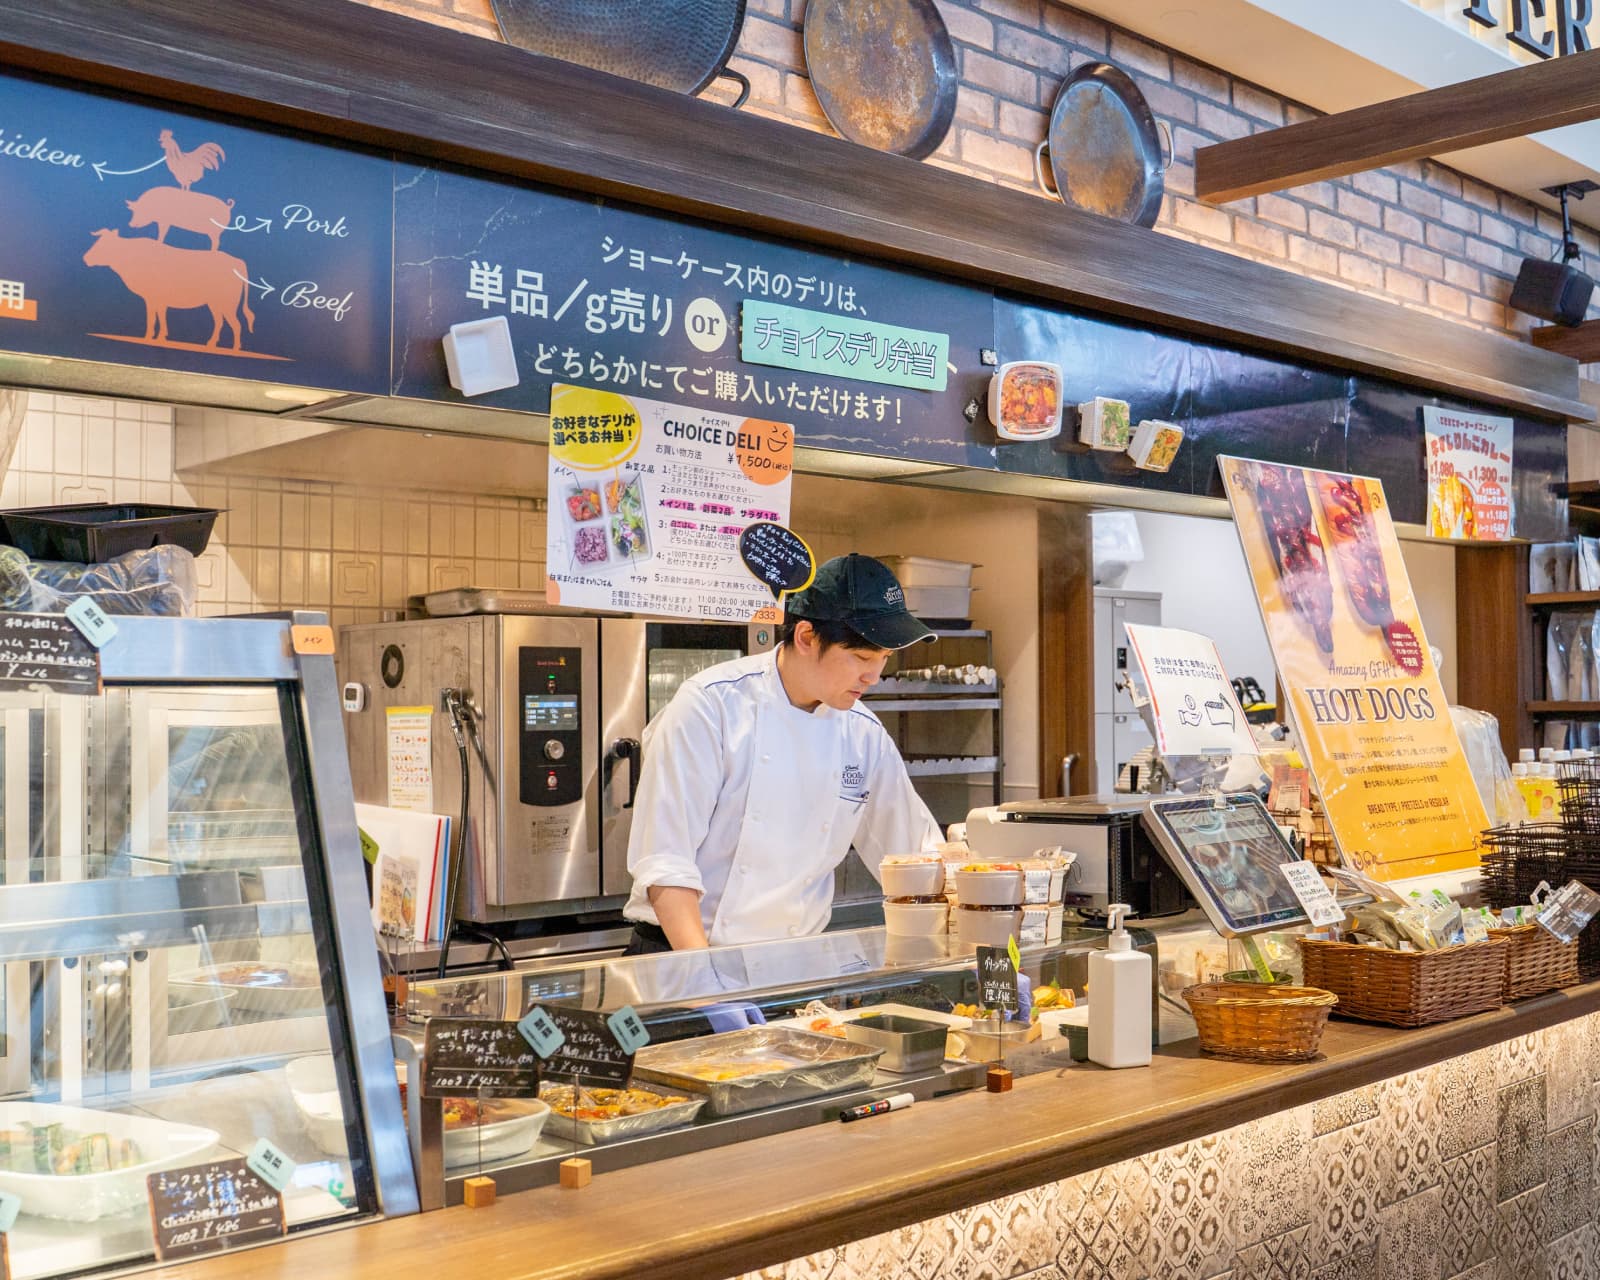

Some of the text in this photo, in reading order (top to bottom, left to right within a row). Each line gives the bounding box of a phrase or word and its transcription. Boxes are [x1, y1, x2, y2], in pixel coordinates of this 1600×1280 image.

[282, 204, 350, 238] Pork
[601, 236, 871, 316] ショーケース内のデリは、
[280, 280, 354, 323] Beef
[691, 311, 721, 335] or
[552, 413, 636, 430] お好きなデリが
[663, 420, 761, 451] CHOICE DELI
[655, 444, 702, 460] お買い物方法
[1328, 660, 1367, 681] Amazing
[1305, 687, 1435, 722] HOT DOGS
[1367, 802, 1385, 814] BREAD
[1384, 801, 1398, 812] TYPE
